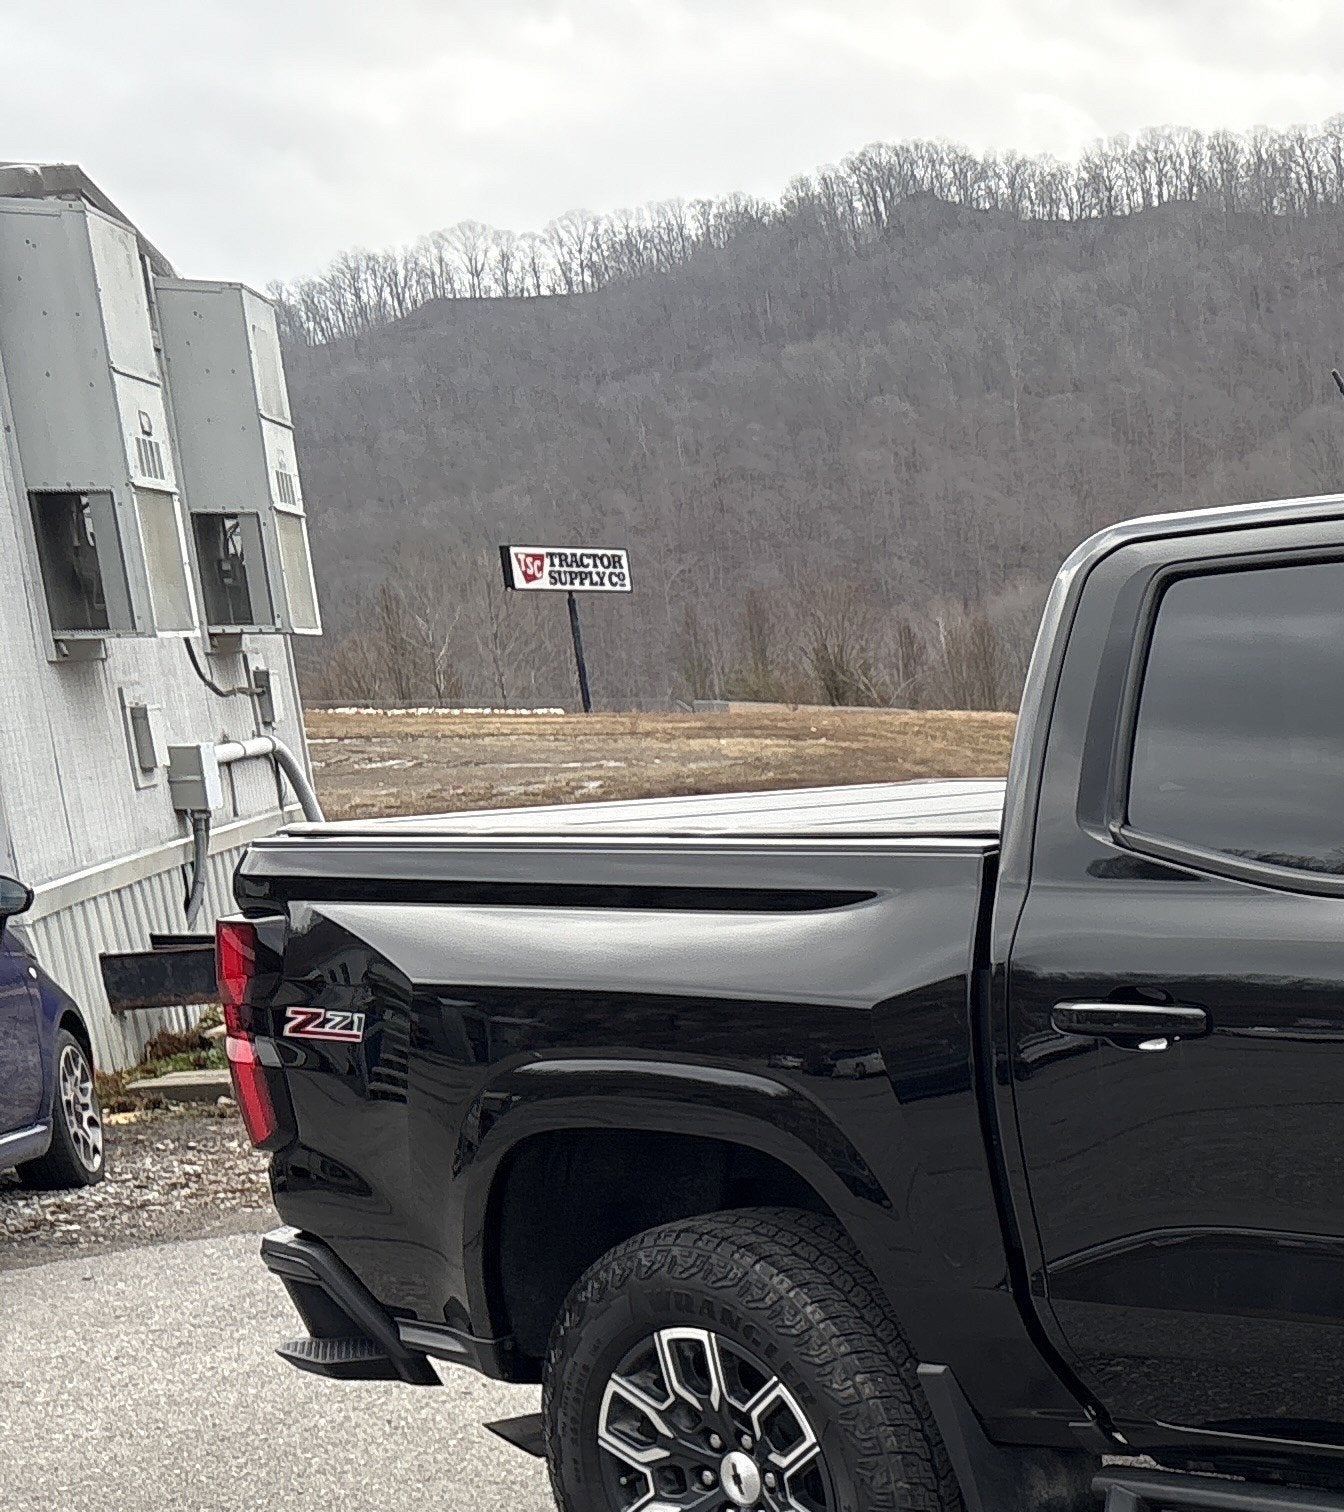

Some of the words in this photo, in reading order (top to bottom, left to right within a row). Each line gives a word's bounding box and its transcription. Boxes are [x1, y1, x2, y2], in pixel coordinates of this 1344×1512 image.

[517, 553, 543, 577] TSC
[546, 552, 624, 569] TRACTOR
[548, 570, 606, 587] SUPPLY
[283, 1006, 366, 1043] Z71
[645, 1288, 817, 1405] WRANGLER
